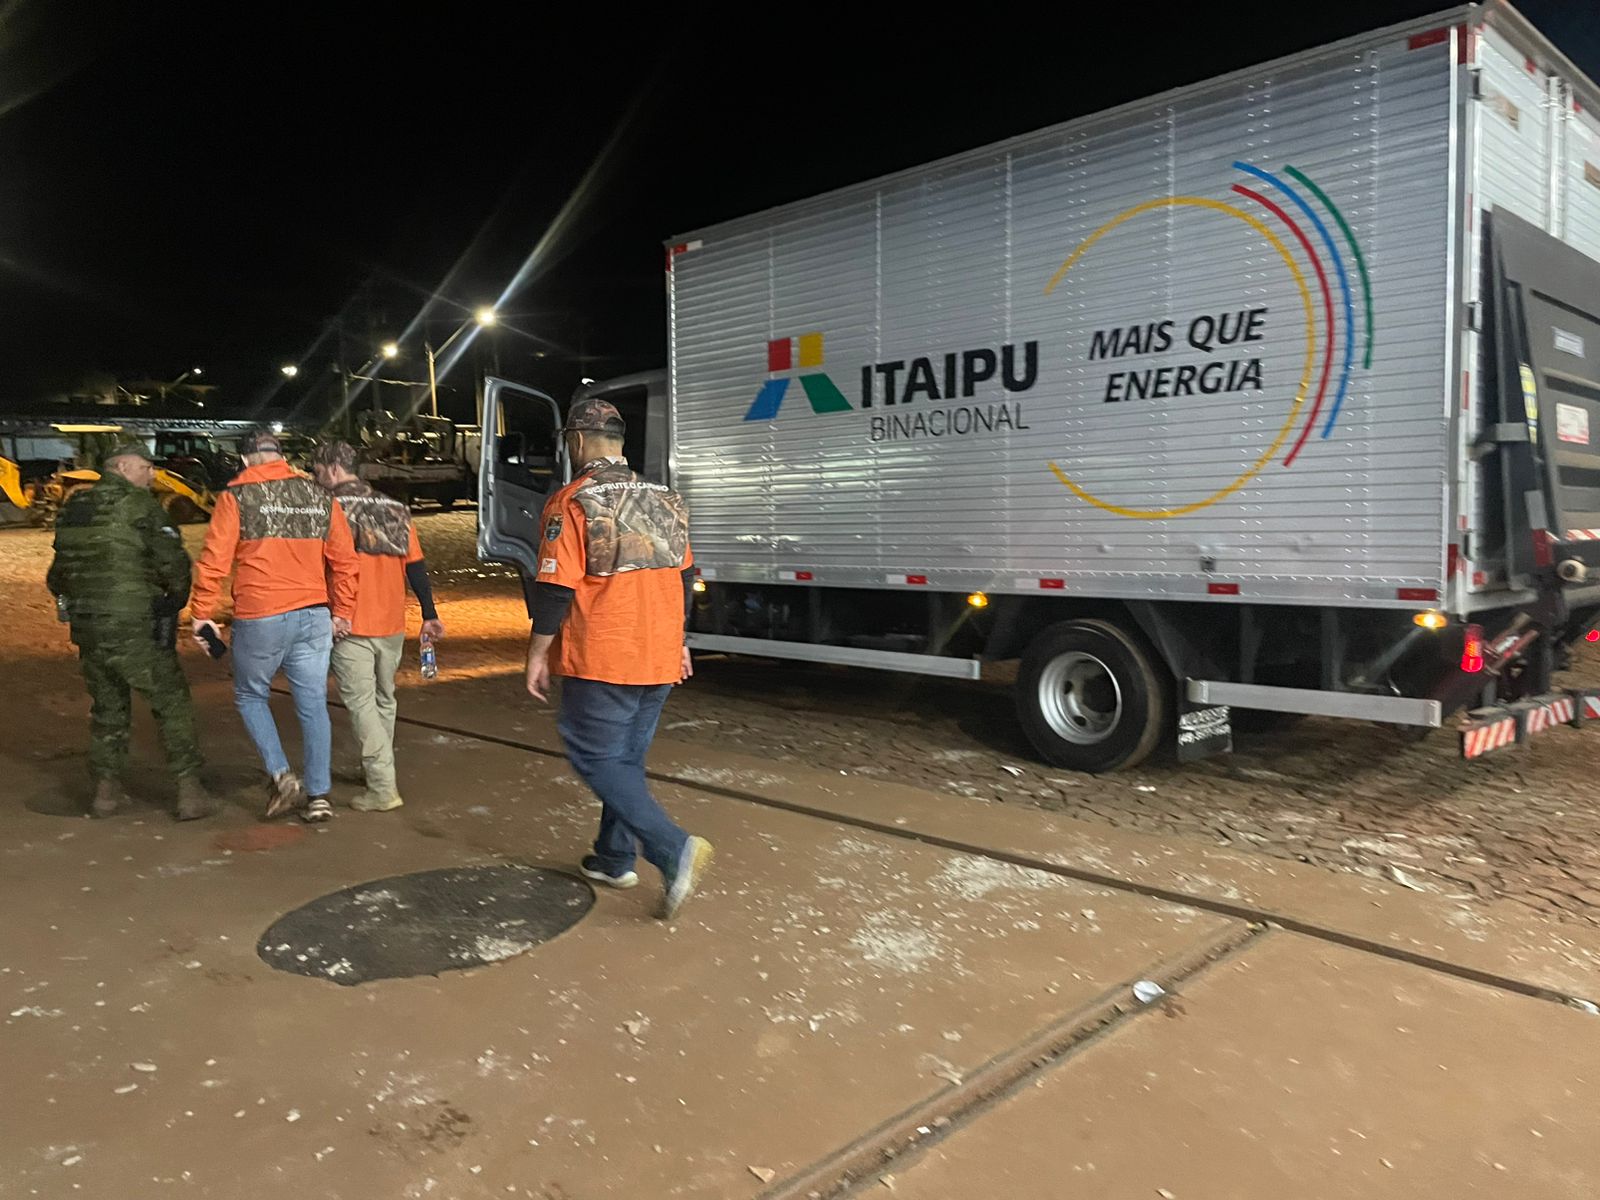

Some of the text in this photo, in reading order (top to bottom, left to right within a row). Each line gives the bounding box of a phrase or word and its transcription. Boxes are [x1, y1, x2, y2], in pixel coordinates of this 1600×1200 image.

[1088, 307, 1268, 360] MAIS QUE
[862, 340, 1038, 409] ITAIPU
[1104, 358, 1263, 403] ENERGIA
[870, 402, 1030, 442] BINACIONAL
